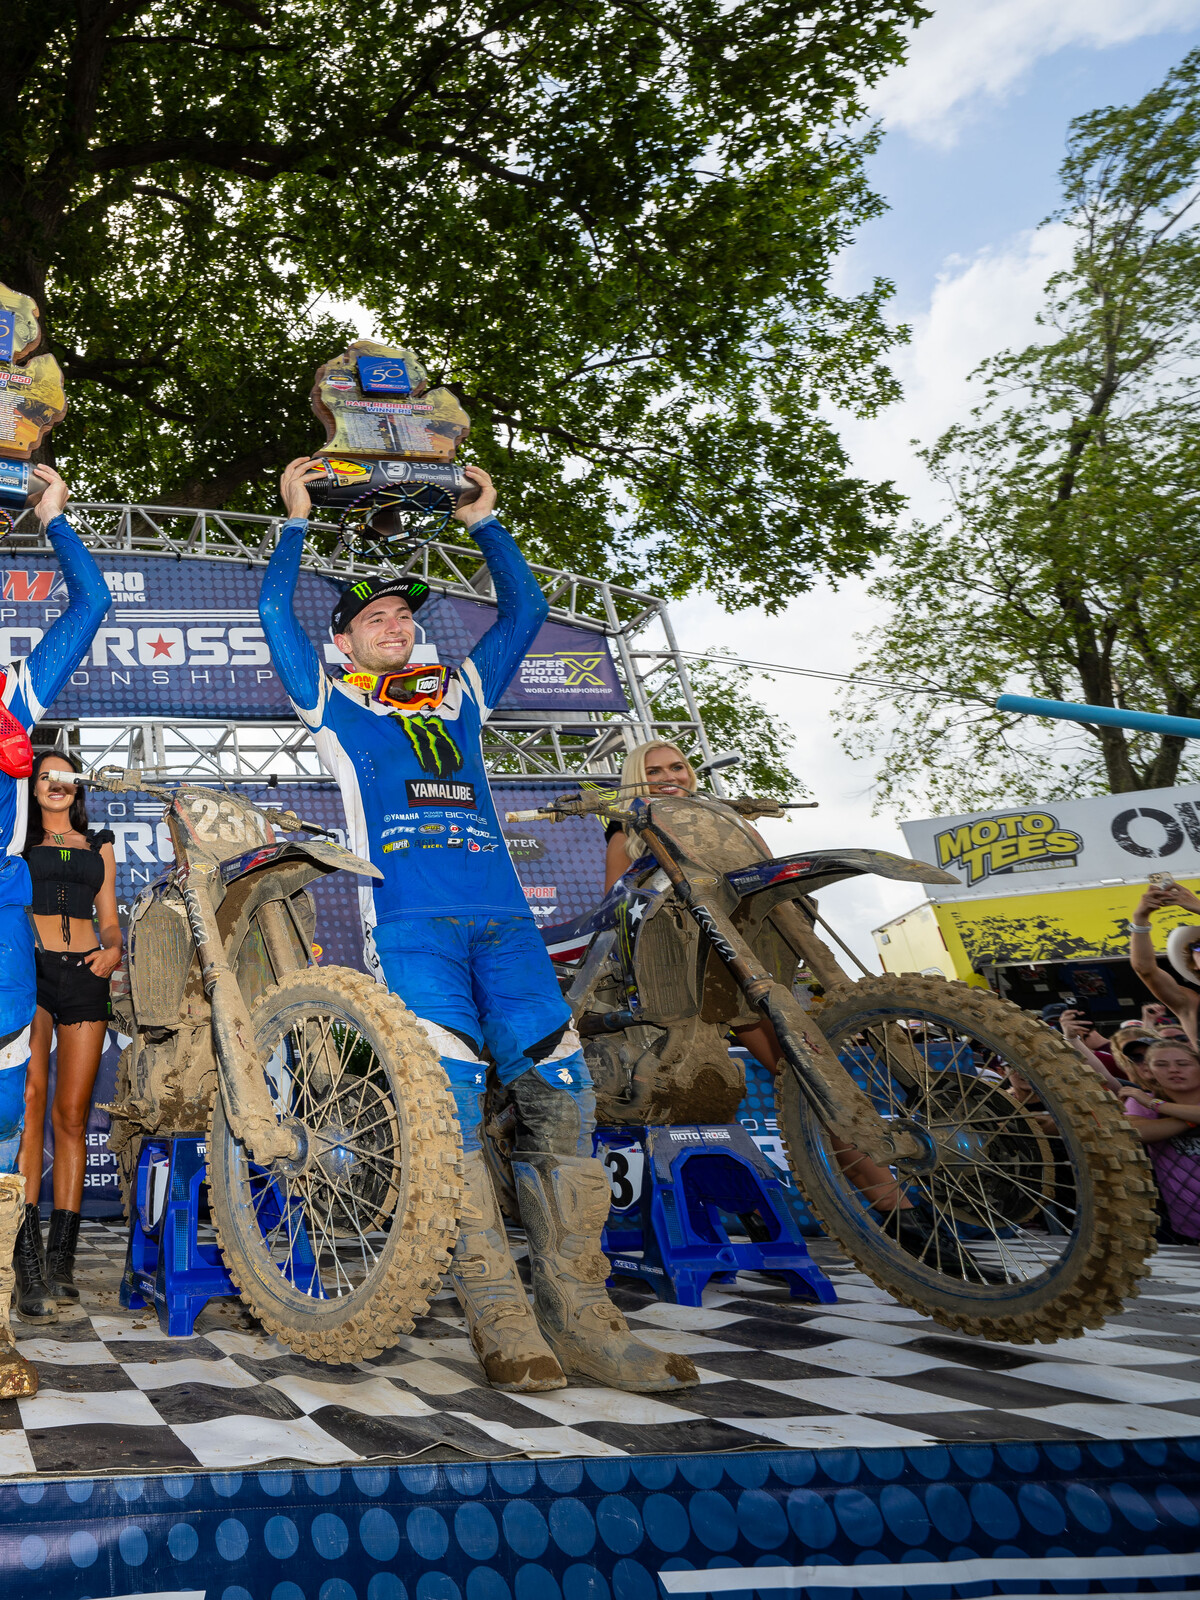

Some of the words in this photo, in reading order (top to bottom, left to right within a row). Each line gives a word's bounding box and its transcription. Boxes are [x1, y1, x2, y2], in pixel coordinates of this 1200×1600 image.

[11, 375, 32, 385] 250
[370, 369, 404, 382] 50
[345, 400, 372, 408] PAST
[372, 402, 413, 410] REDBUD
[386, 463, 406, 477] 3
[411, 463, 450, 471] 250cc
[519, 660, 565, 668] SUPER
[419, 680, 437, 690] 100%
[411, 784, 474, 800] YAMALUBE
[390, 812, 420, 821] YAMAHA
[938, 814, 1054, 865] MOTO
[962, 832, 1080, 881] TEES
[669, 1131, 732, 1141] MOTOCROSS
[604, 1152, 634, 1208] 3
